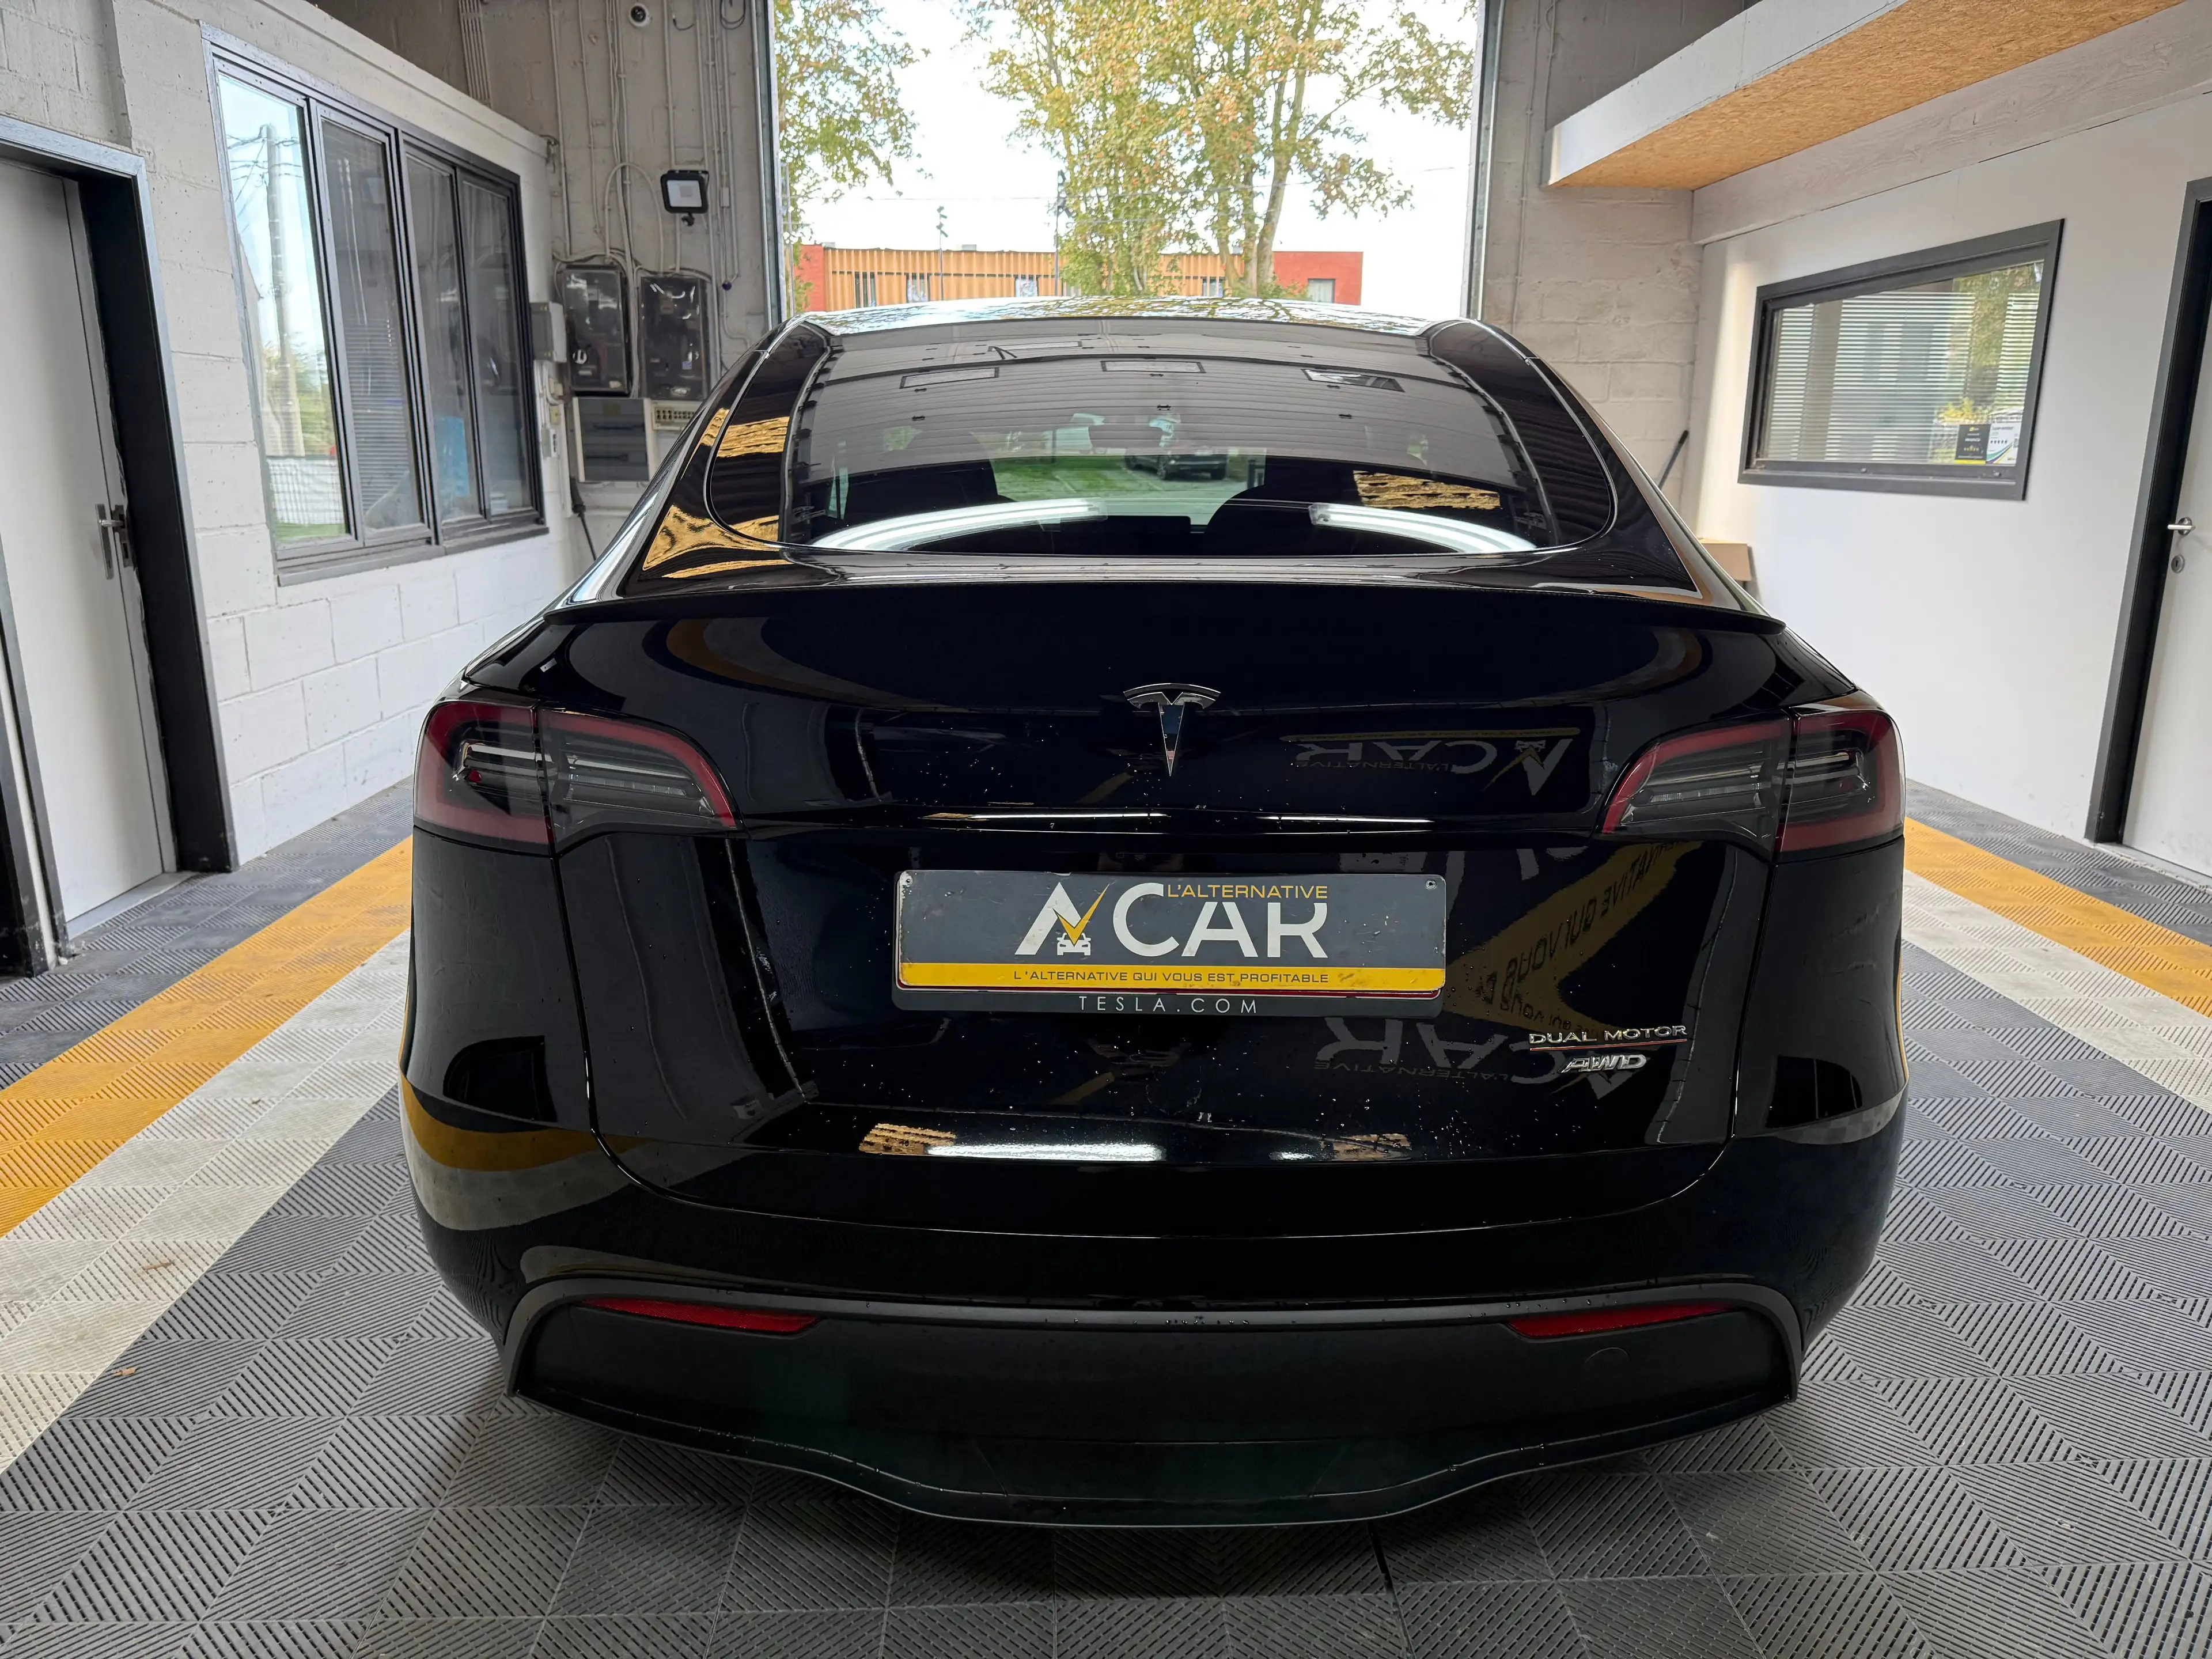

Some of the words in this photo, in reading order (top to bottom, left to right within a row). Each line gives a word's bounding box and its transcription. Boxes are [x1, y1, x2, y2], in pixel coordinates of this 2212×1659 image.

[1167, 884, 1328, 899] L'ALTERNATIVE
[1132, 972, 1157, 982] QUI
[1162, 973, 1202, 982] VOUS
[1207, 973, 1235, 983] EST
[1240, 974, 1329, 983] PROFITABLE
[1529, 1031, 1597, 1044] DUAL
[1604, 1025, 1688, 1041] MOTOR
[1557, 1053, 1647, 1074] AWD
